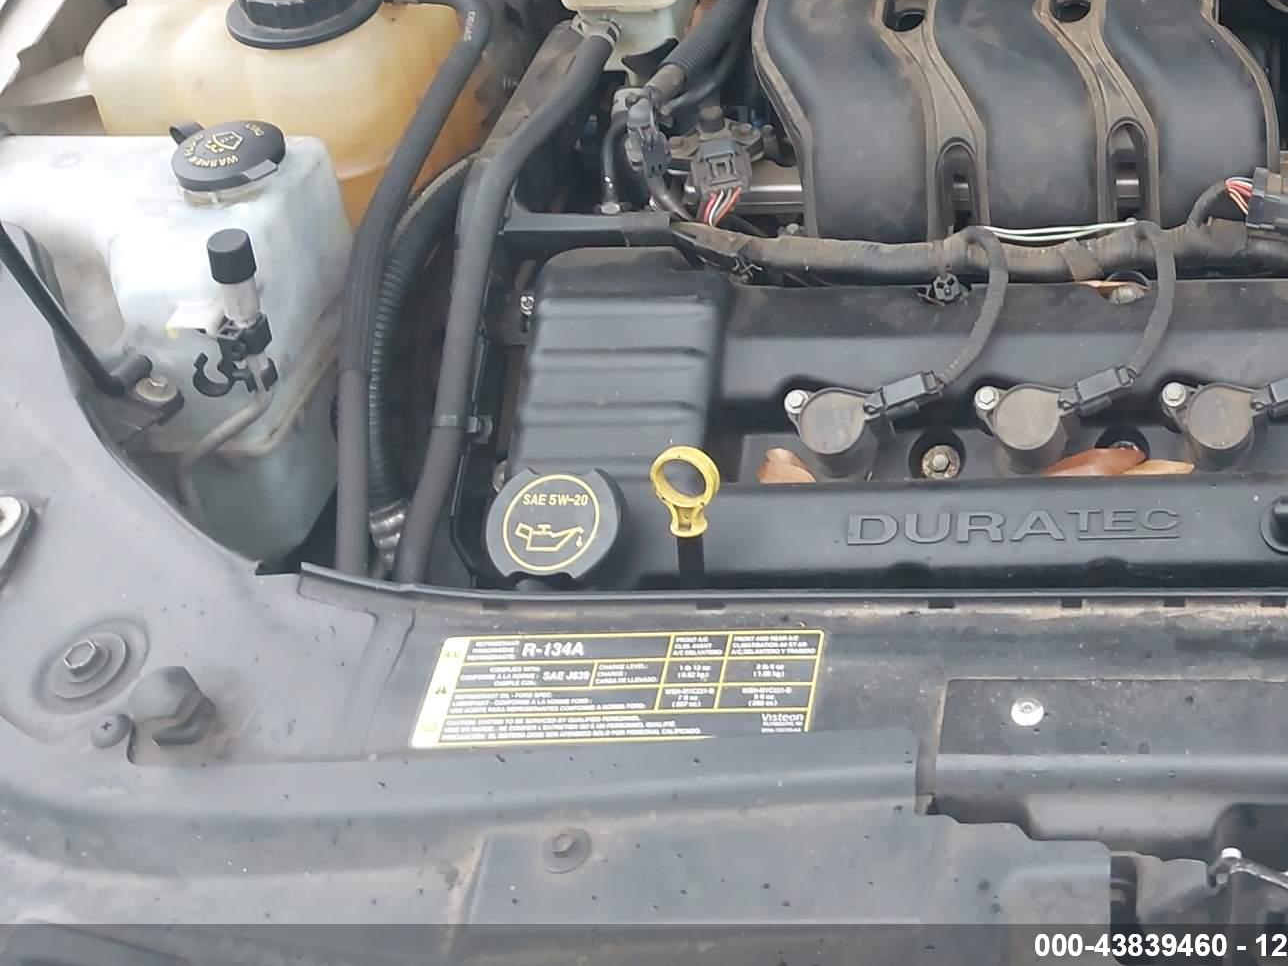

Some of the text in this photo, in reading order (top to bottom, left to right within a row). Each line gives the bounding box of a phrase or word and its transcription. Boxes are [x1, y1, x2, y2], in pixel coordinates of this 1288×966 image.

[522, 494, 589, 506] SAE 5W-20
[846, 508, 1181, 547] DURATEC
[521, 641, 585, 657] R-134A
[542, 672, 565, 681] SAE
[761, 713, 804, 721] Visteon
